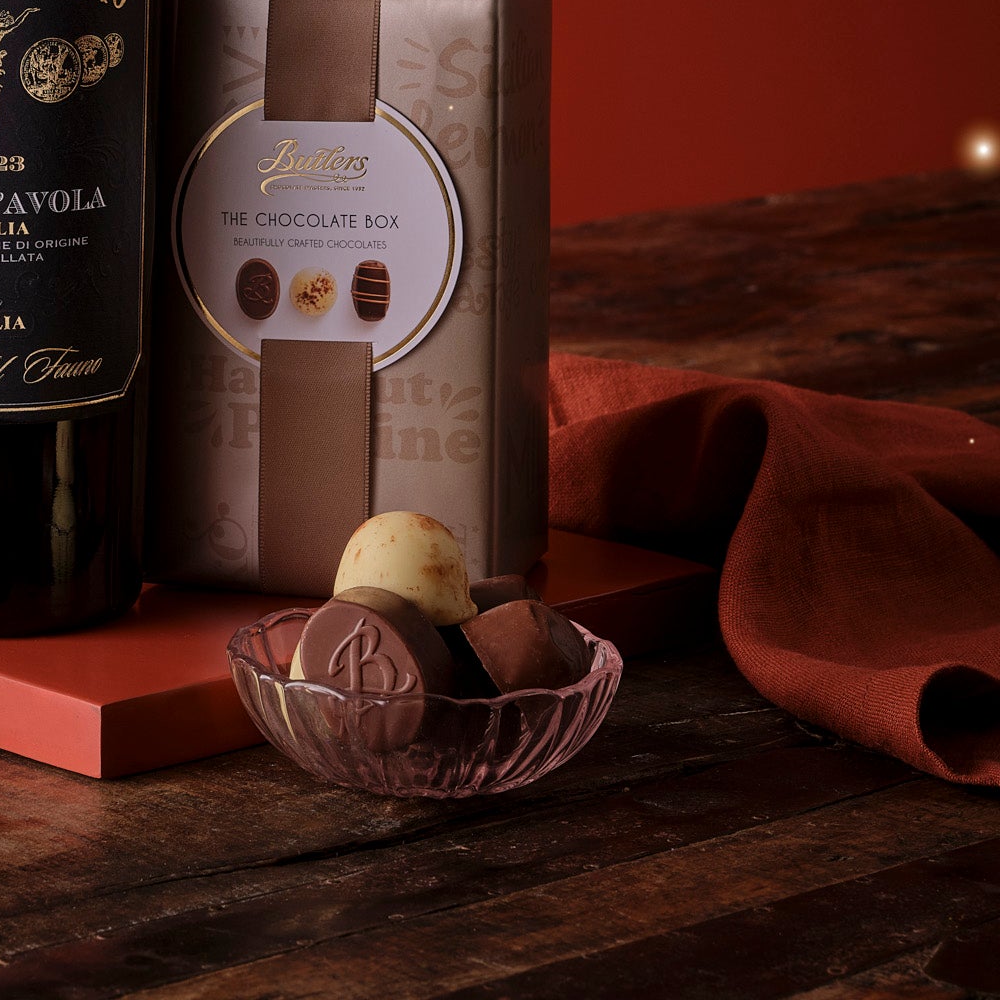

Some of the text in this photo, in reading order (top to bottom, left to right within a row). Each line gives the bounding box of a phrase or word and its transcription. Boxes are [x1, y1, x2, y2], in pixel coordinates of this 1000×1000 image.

[257, 138, 369, 174] Butlers
[221, 211, 400, 229] THE CHOCOLATE BOX
[16, 240, 30, 250] DI
[34, 236, 89, 249] ORIGINE
[233, 237, 387, 250] BEAUTIFULLY CRAFTED CHOCOLATES
[23, 346, 103, 384] Fauno
